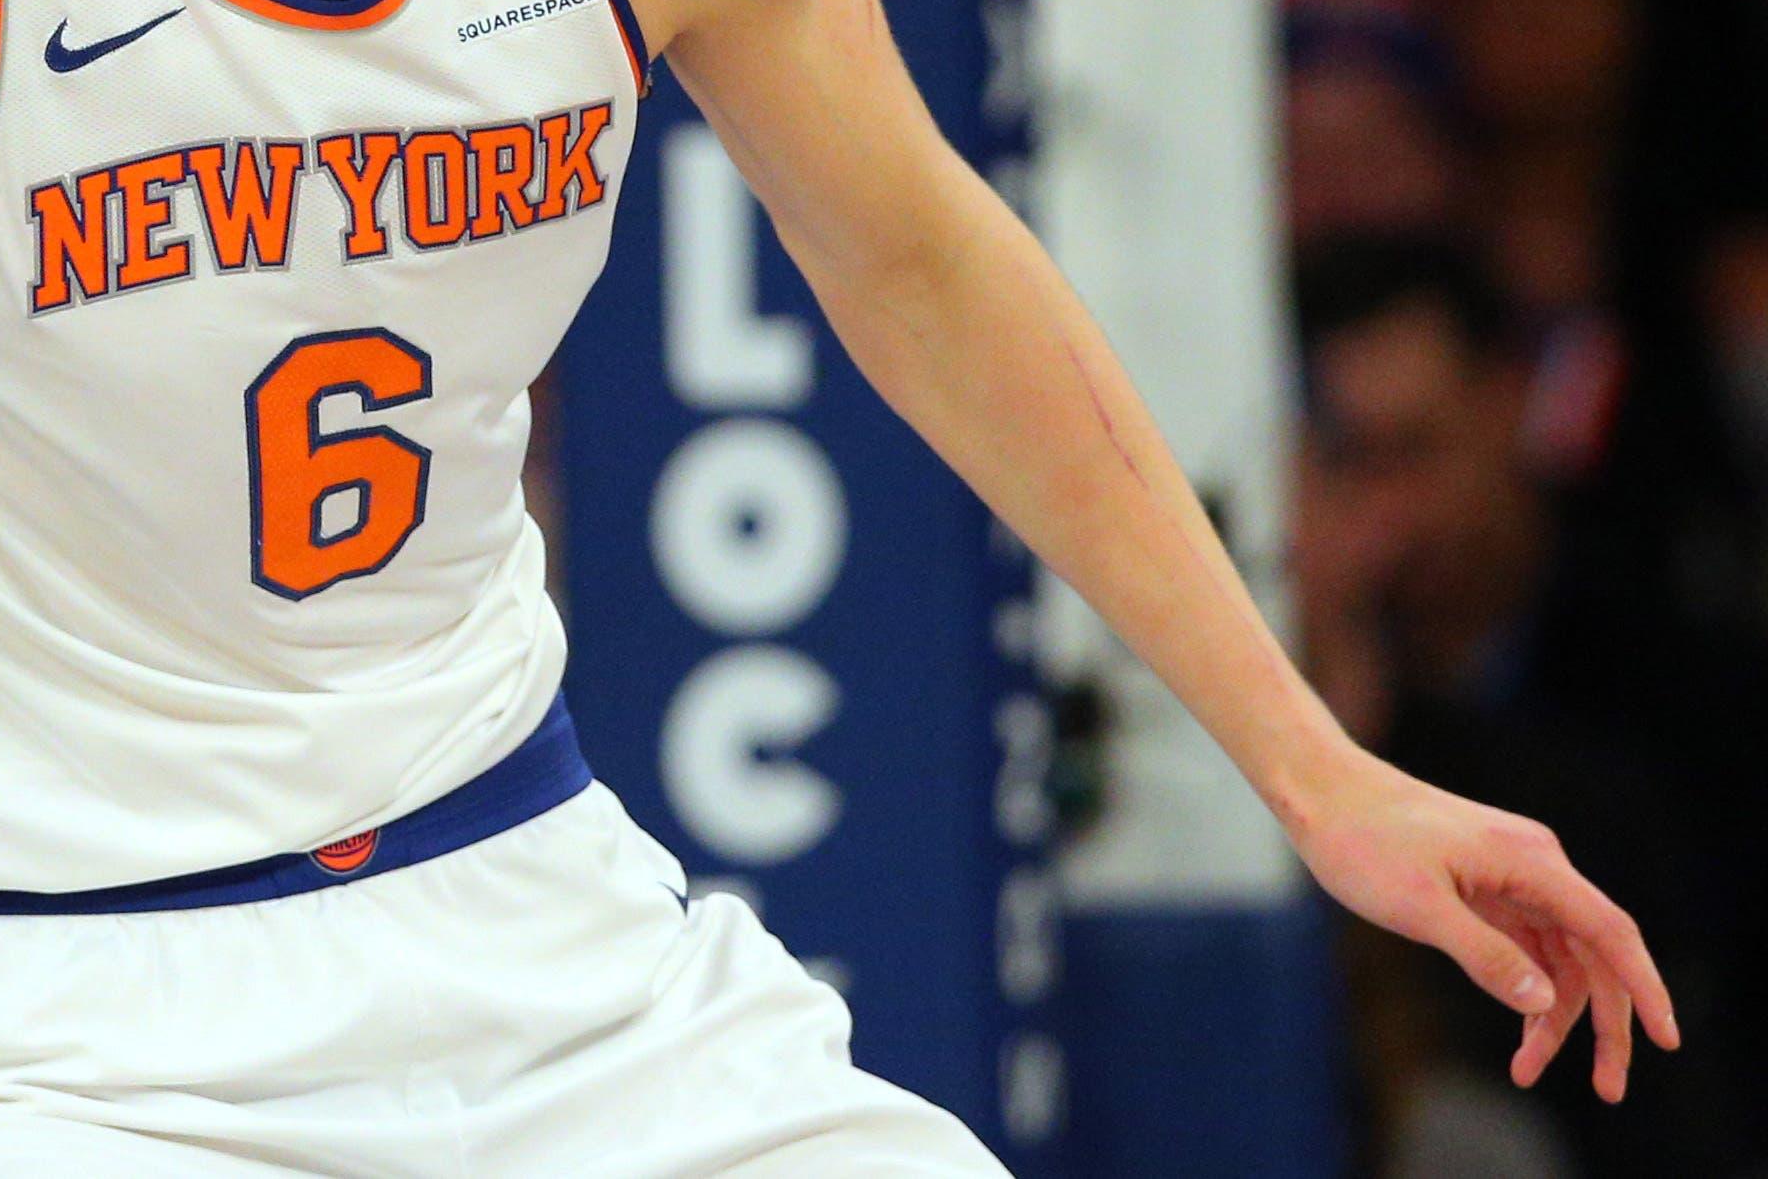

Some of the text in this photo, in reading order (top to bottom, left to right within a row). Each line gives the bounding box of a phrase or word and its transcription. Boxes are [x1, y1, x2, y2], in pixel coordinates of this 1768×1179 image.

[25, 96, 616, 319] NEW YORK
[243, 326, 433, 602] 6
